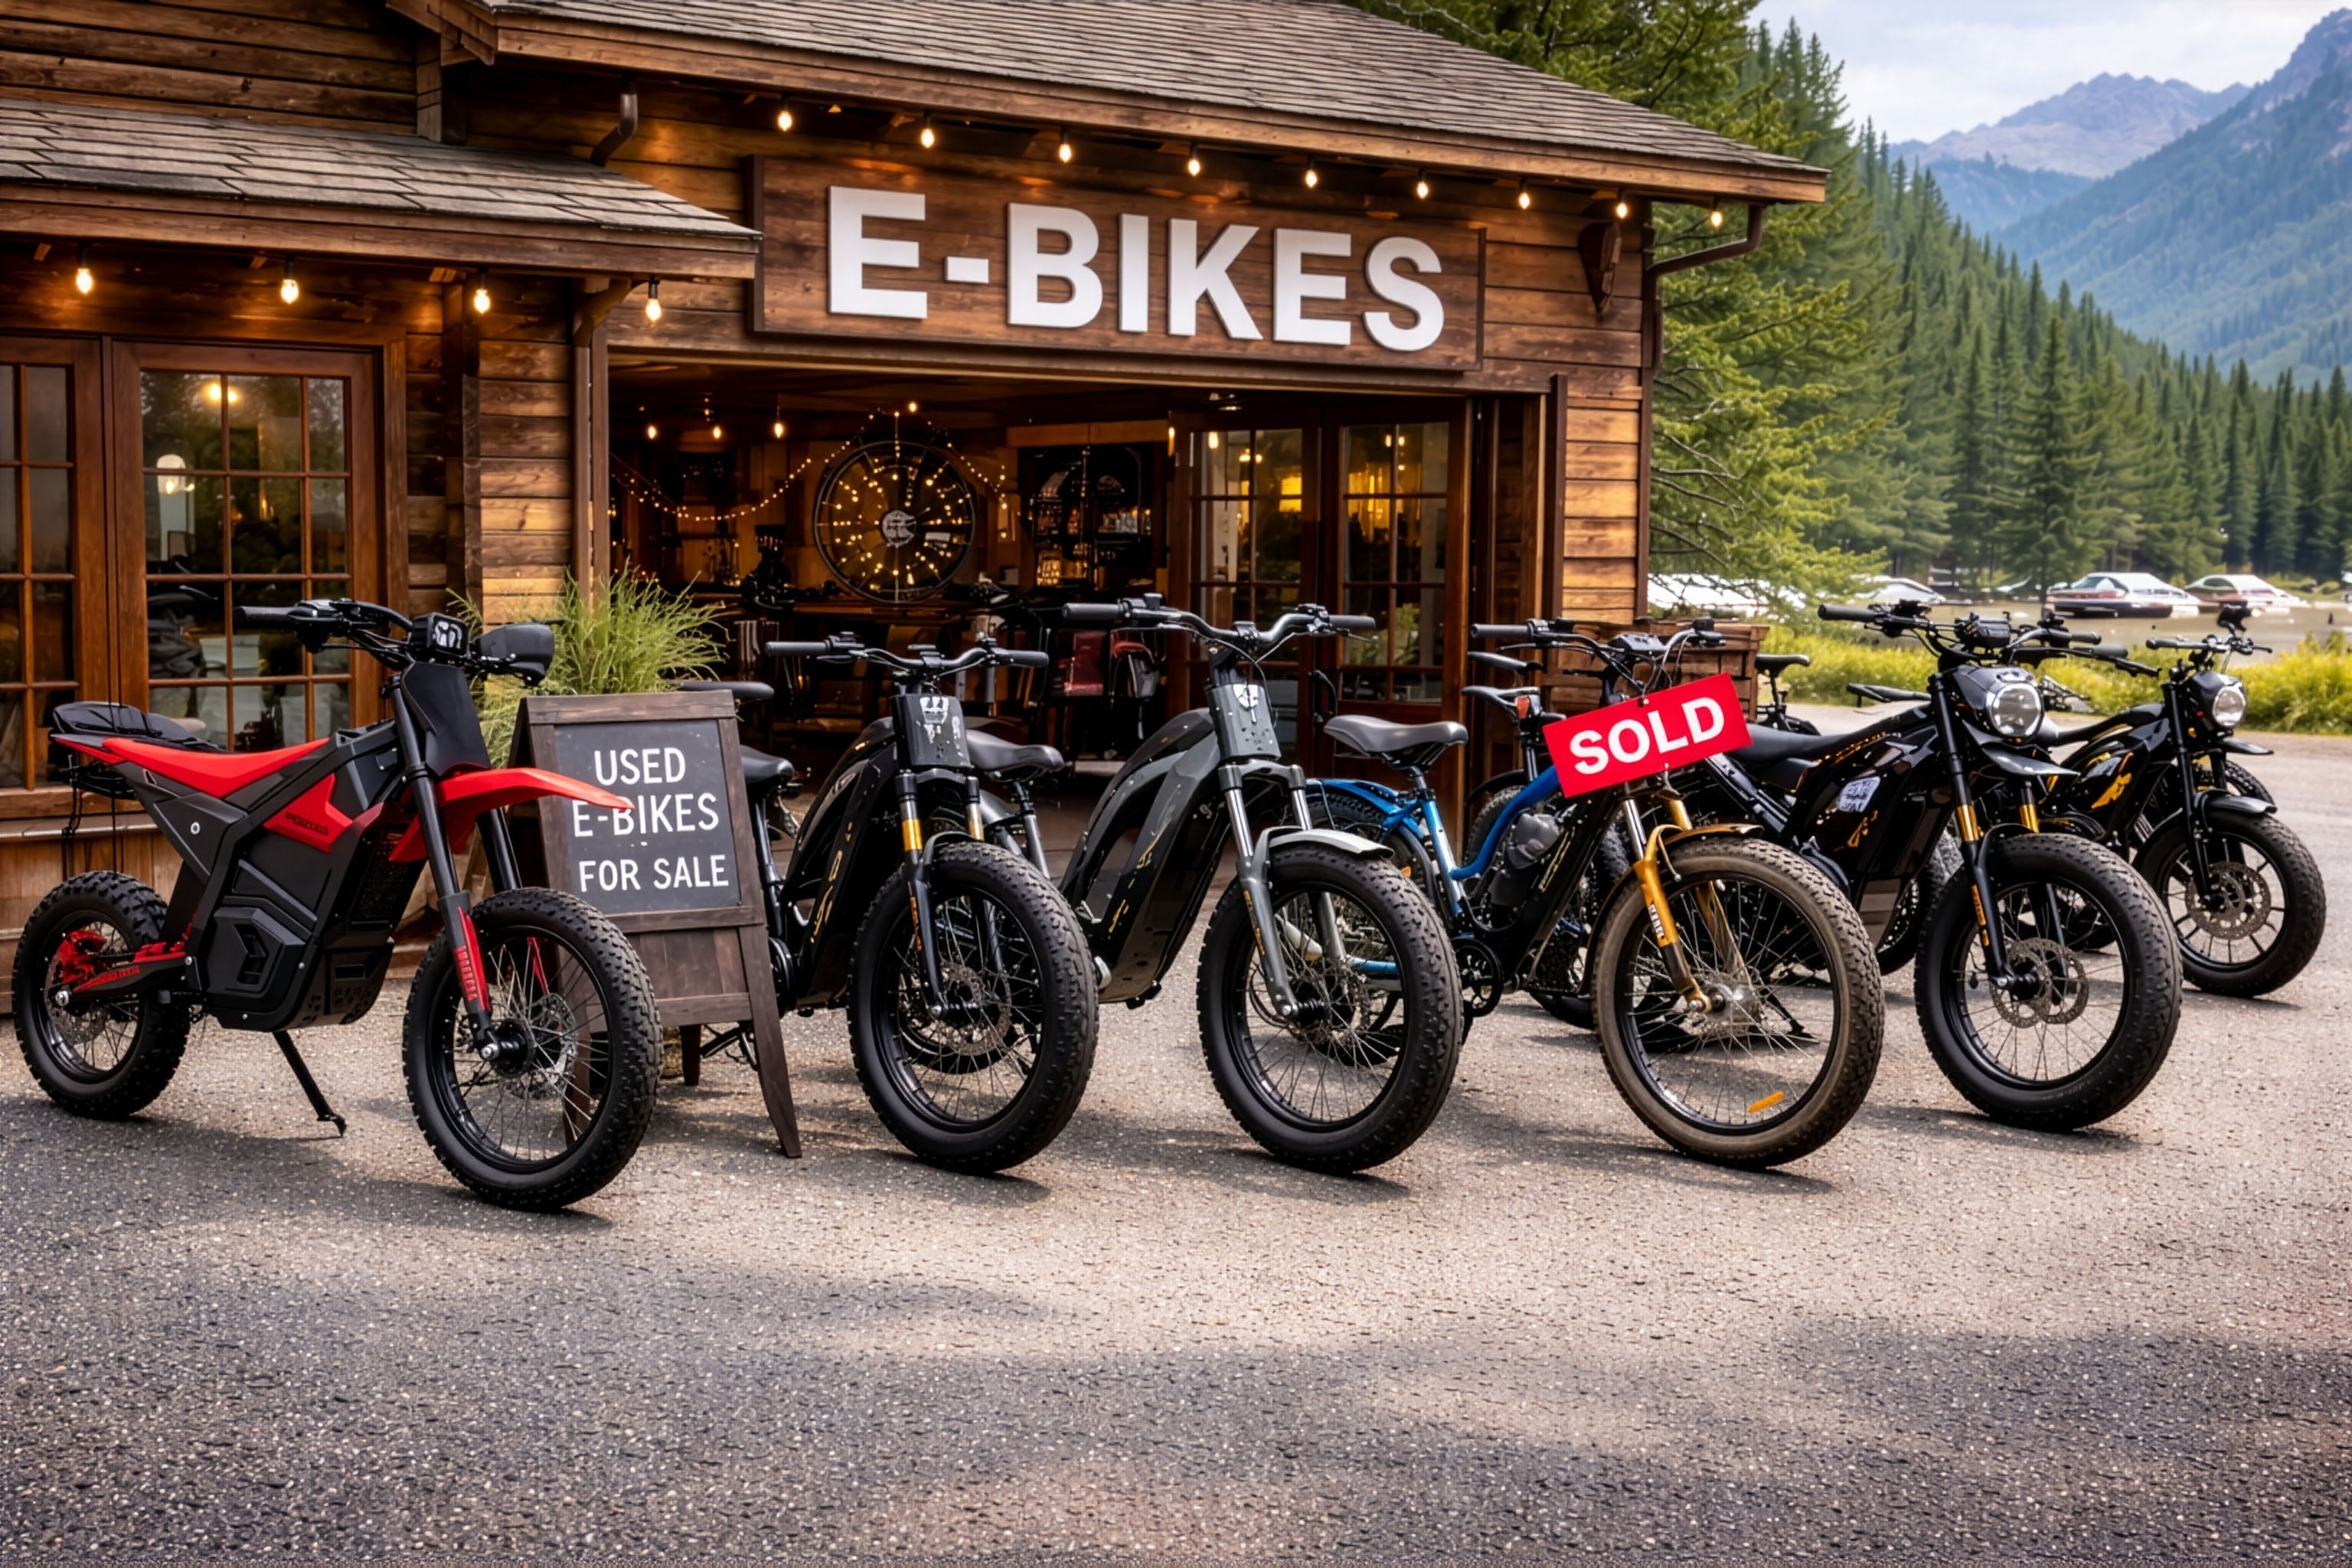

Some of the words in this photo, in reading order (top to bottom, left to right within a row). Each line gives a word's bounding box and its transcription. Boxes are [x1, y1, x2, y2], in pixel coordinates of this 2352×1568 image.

[829, 185, 1445, 351] E-BIKES
[1570, 697, 1724, 775] SOLD
[594, 747, 686, 786] USED
[572, 792, 719, 837] E-BIKES
[579, 859, 641, 892] FOR
[653, 854, 729, 890] SALE
